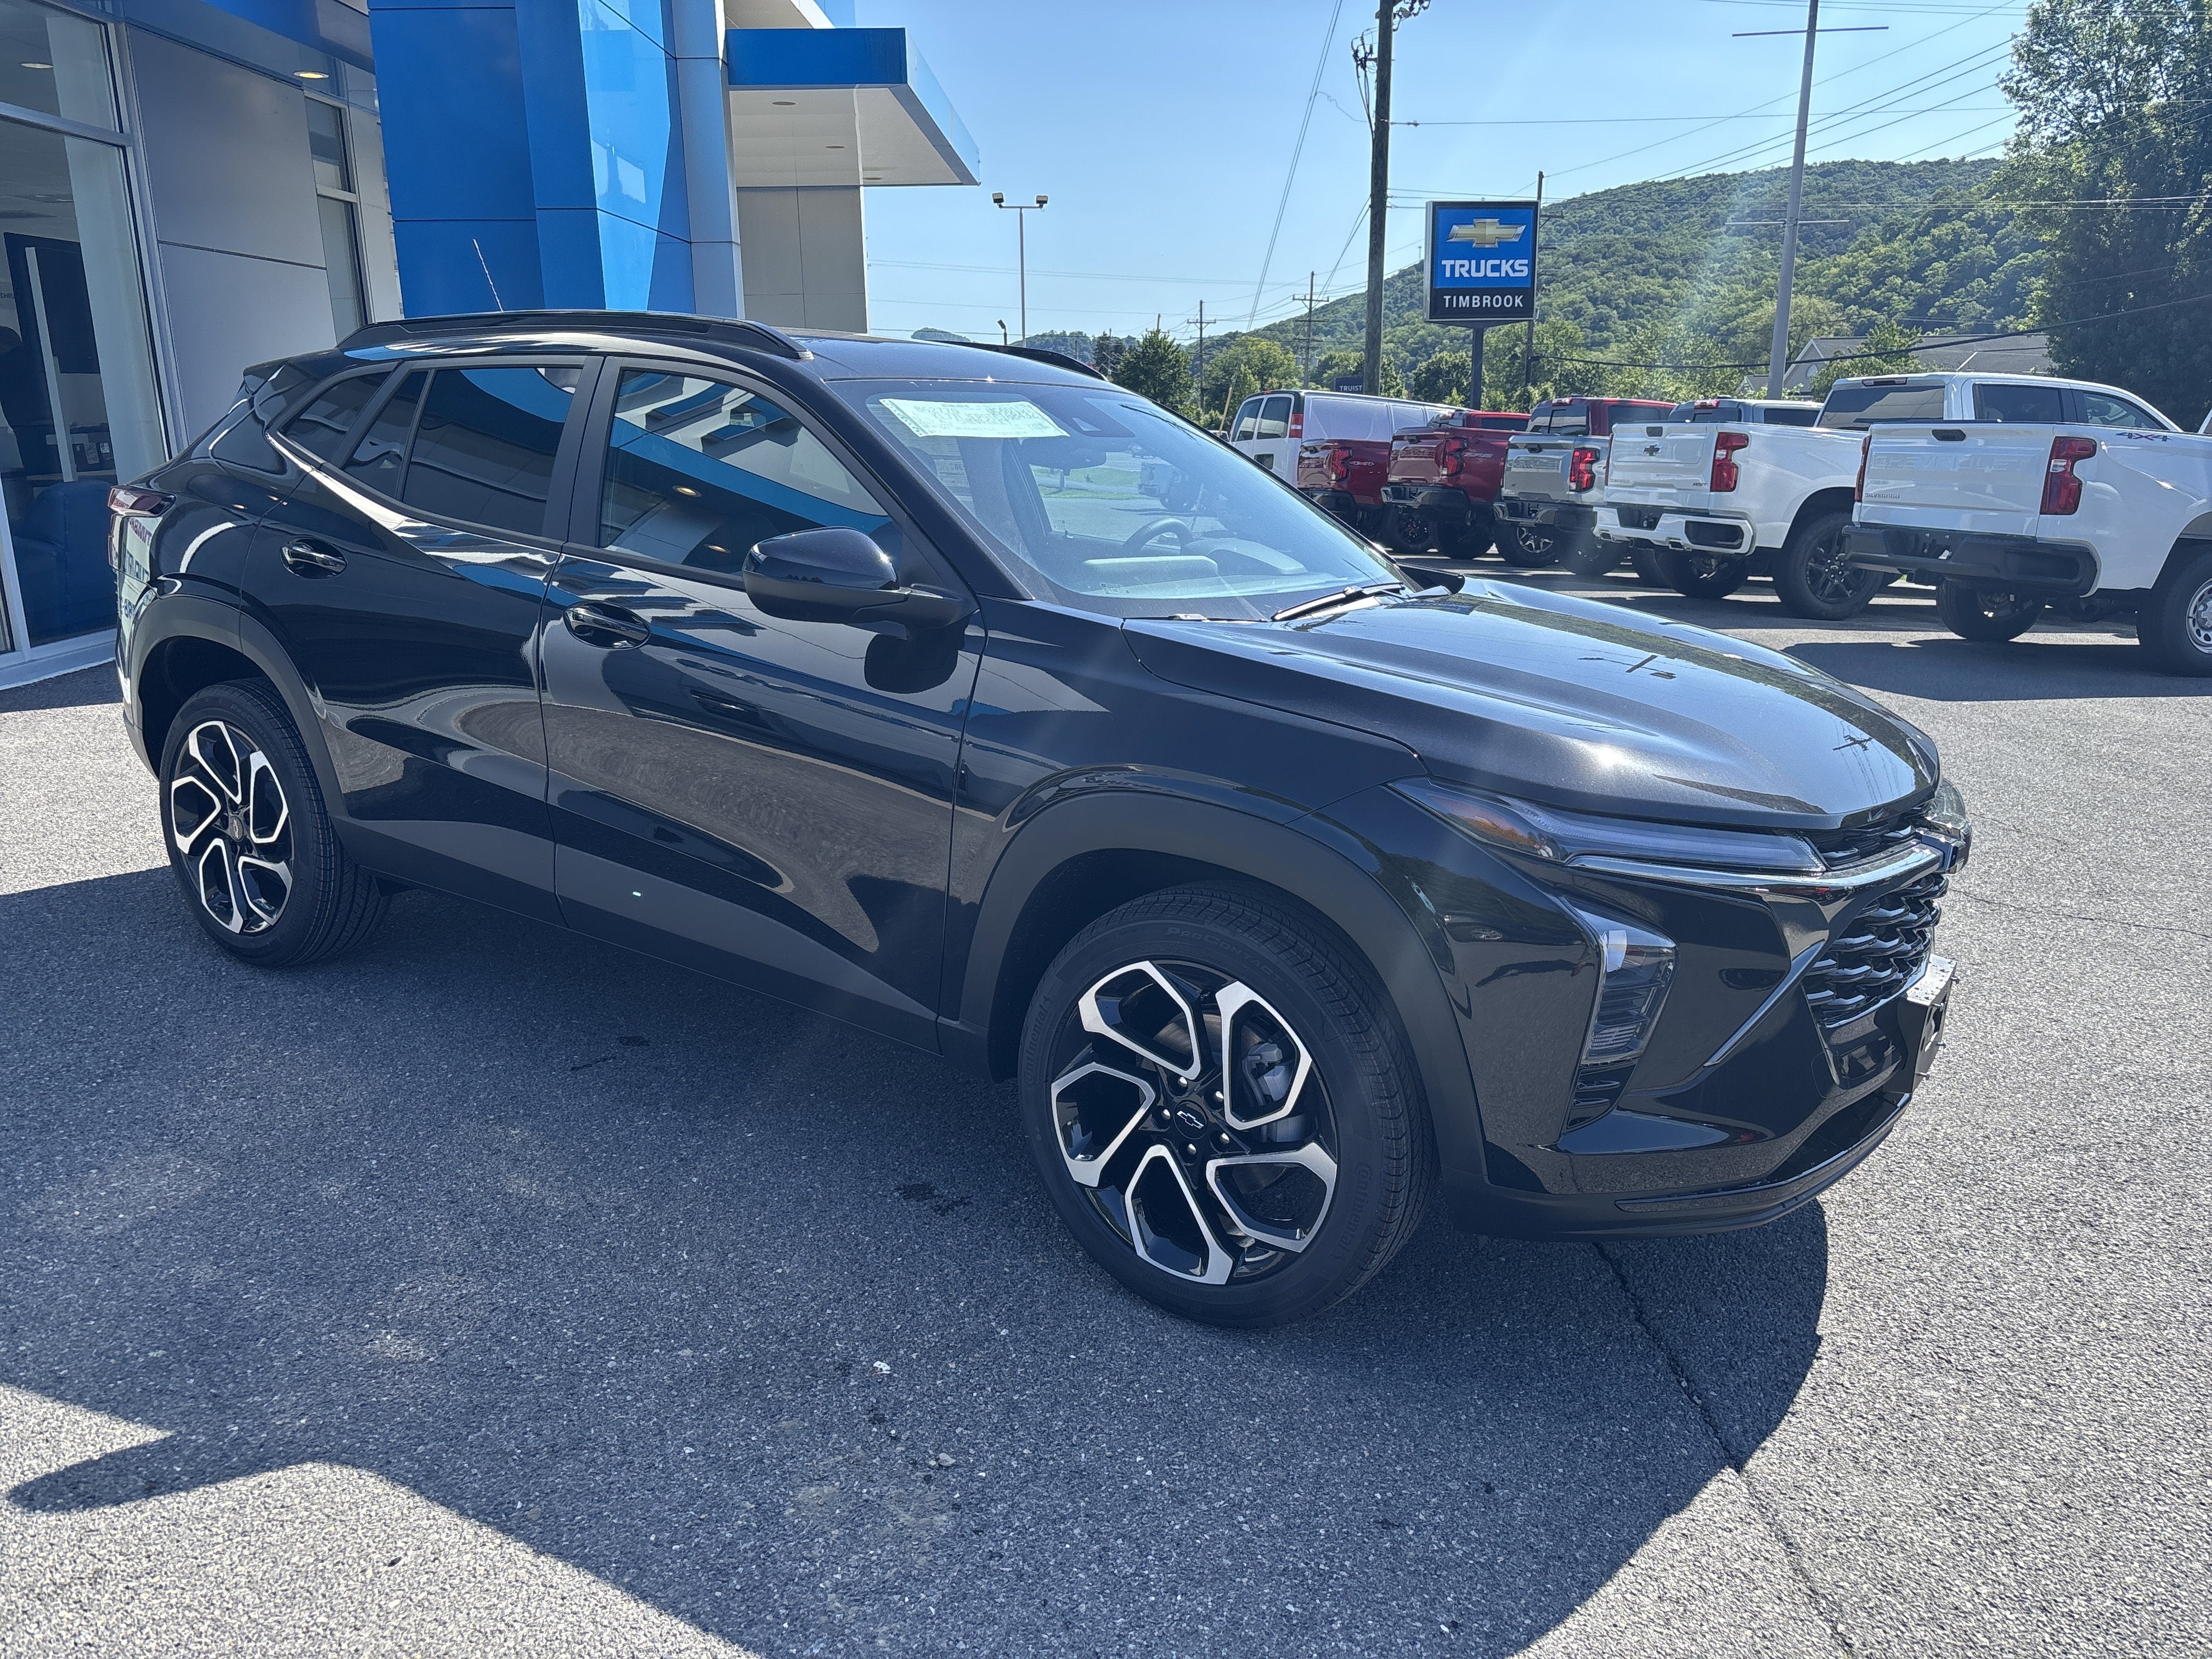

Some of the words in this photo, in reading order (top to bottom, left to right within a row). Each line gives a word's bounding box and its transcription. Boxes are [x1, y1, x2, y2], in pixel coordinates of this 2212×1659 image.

[1441, 259, 1528, 278] TRUCKS
[1443, 295, 1523, 308] TIMBROOK
[1024, 1004, 1049, 1085] Continental
[1337, 1161, 1373, 1252] Continental
